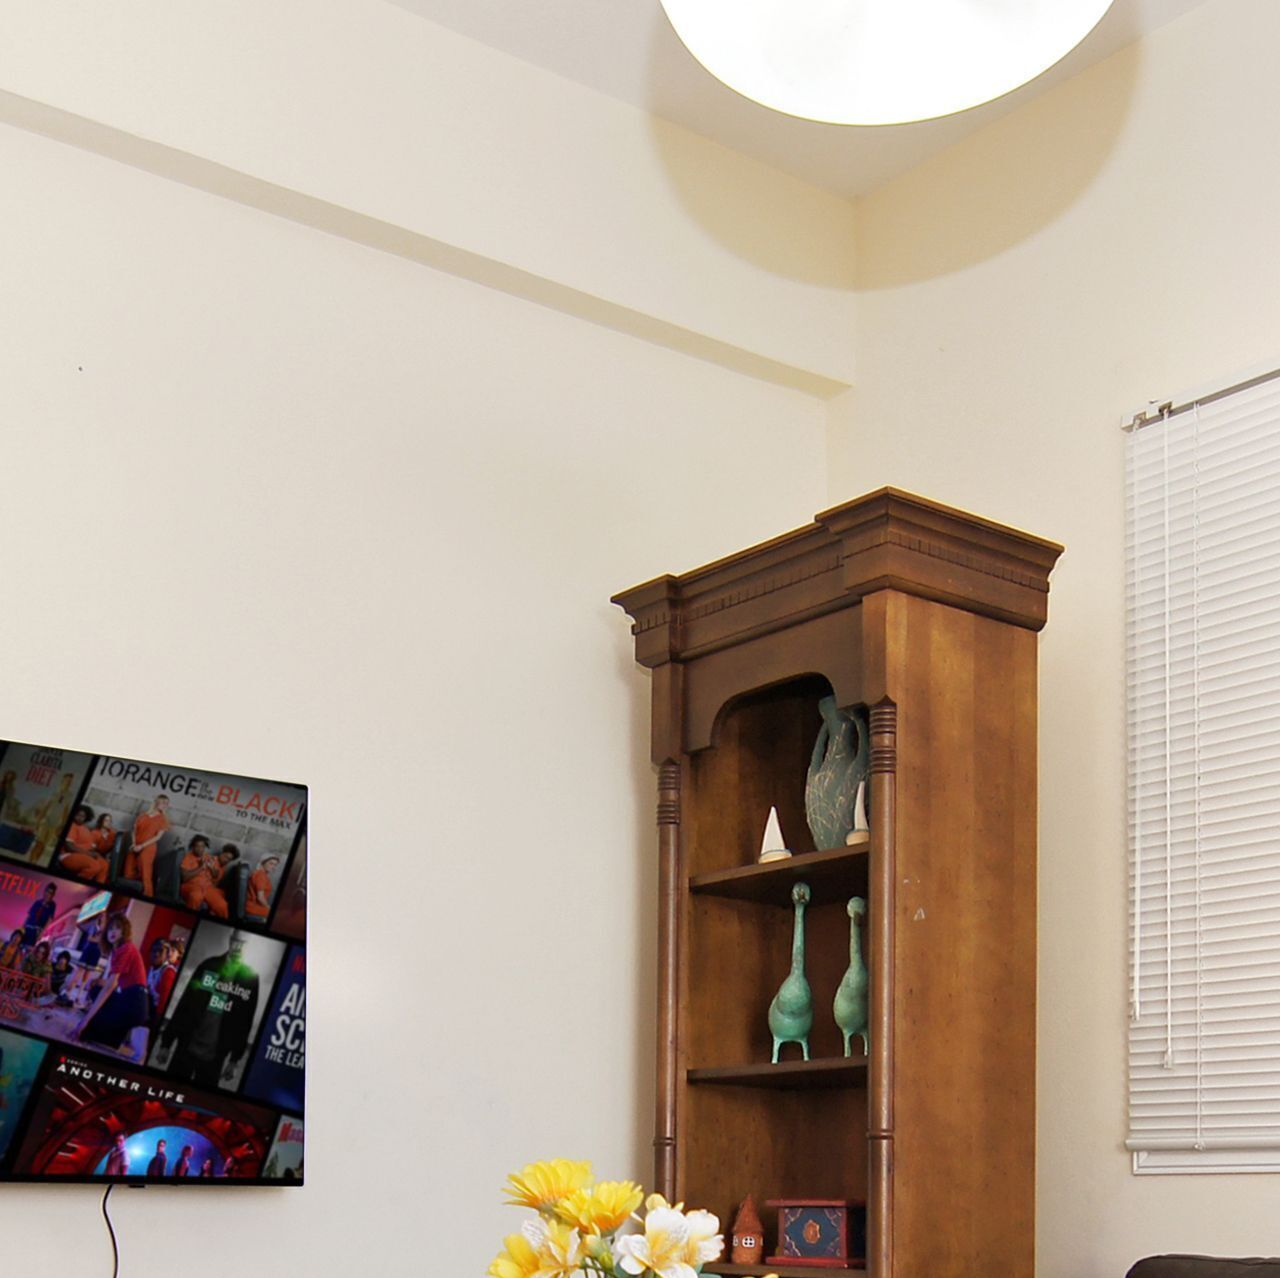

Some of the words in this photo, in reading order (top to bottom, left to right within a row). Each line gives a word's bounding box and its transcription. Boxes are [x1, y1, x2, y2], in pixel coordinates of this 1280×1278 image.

[25, 766, 57, 787] DIET
[108, 760, 201, 797] ORANGE
[215, 784, 297, 821] BLACK
[235, 809, 248, 819] TO
[250, 813, 268, 823] THE
[269, 817, 291, 829] MAX
[202, 974, 252, 1001] Breaking
[209, 995, 234, 1012] Bad
[270, 1014, 305, 1053] SC
[264, 1044, 286, 1064] THE
[56, 1063, 140, 1092] ANOTHER
[147, 1085, 185, 1104] LIFE
